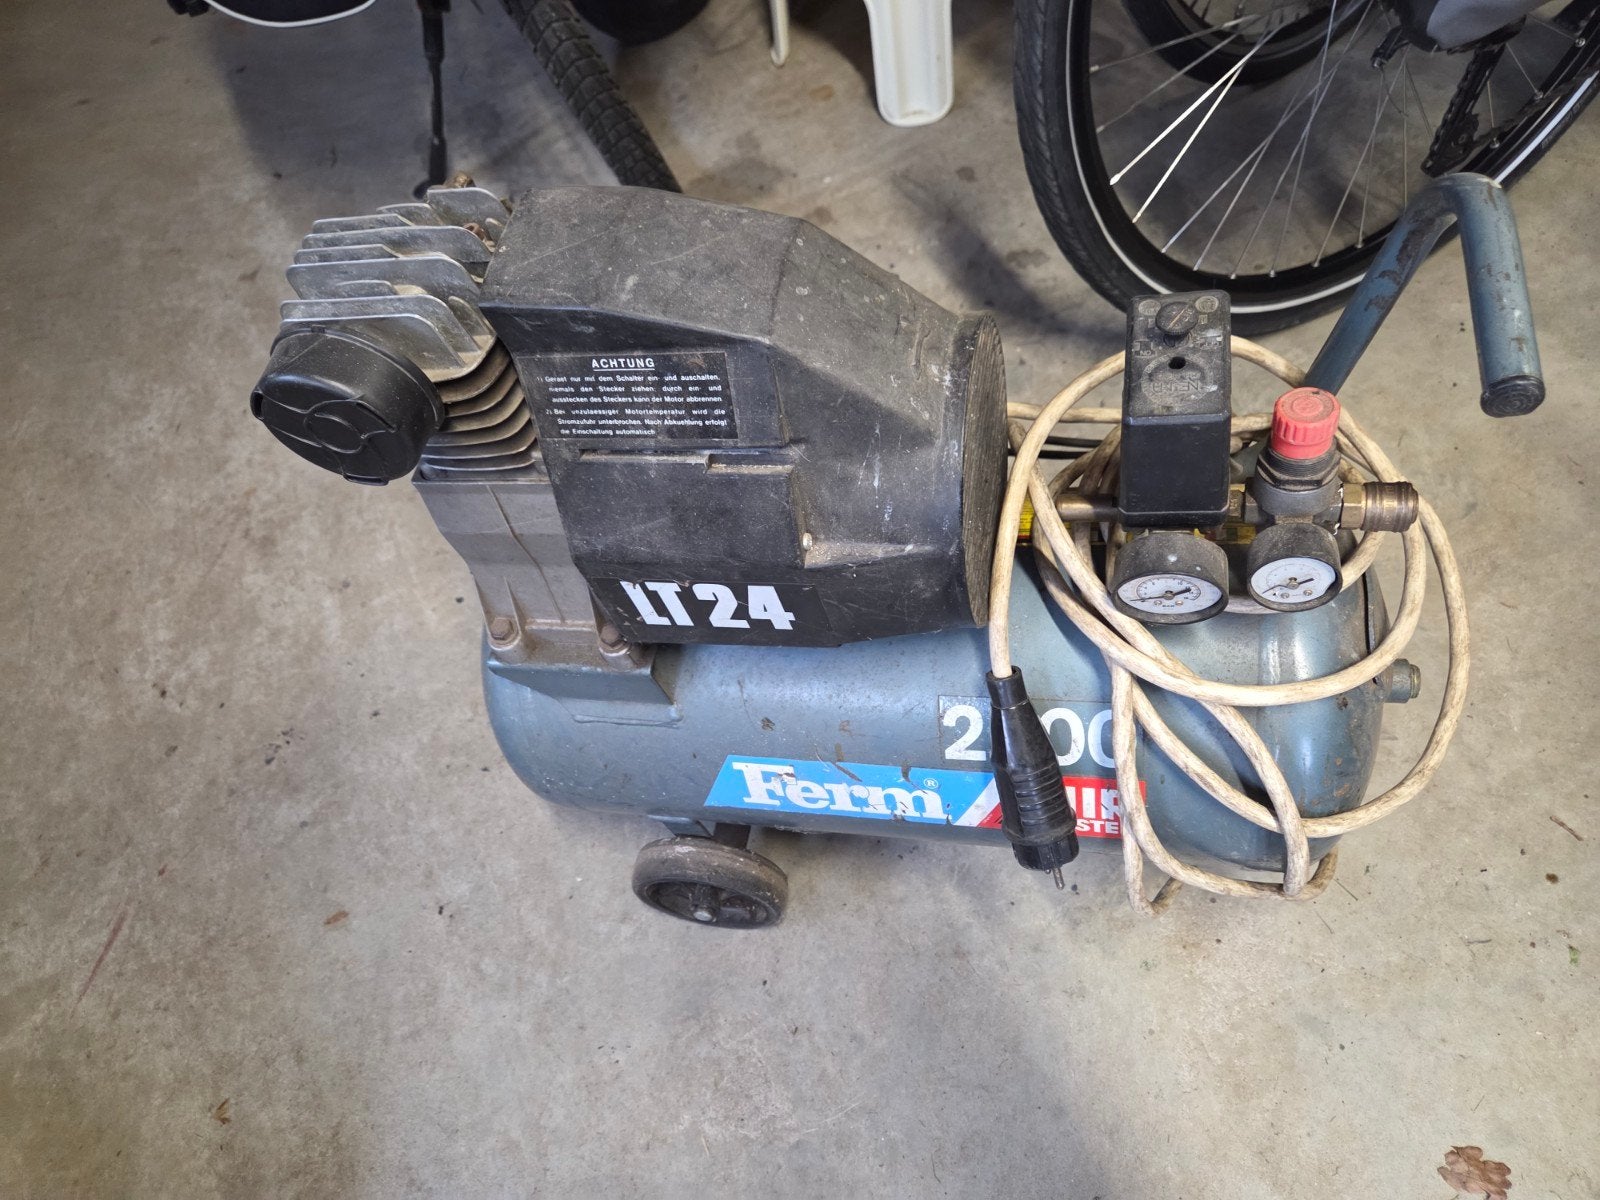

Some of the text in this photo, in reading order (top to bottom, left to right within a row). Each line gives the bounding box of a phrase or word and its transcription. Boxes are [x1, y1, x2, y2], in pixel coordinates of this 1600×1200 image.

[591, 358, 655, 369] ACHTUNG
[616, 374, 644, 382] Schalter
[662, 385, 682, 393] durch
[603, 395, 632, 403] Steckers
[625, 408, 685, 416] Motortemperatur
[692, 407, 708, 415] wird
[664, 419, 703, 427] Abkuehlung
[705, 419, 728, 427] erfolgt
[572, 428, 613, 436] Einschaltung
[692, 582, 796, 631] 24
[943, 704, 1119, 769] 200
[732, 761, 952, 820] Ferm
[1074, 819, 1120, 835] STE
